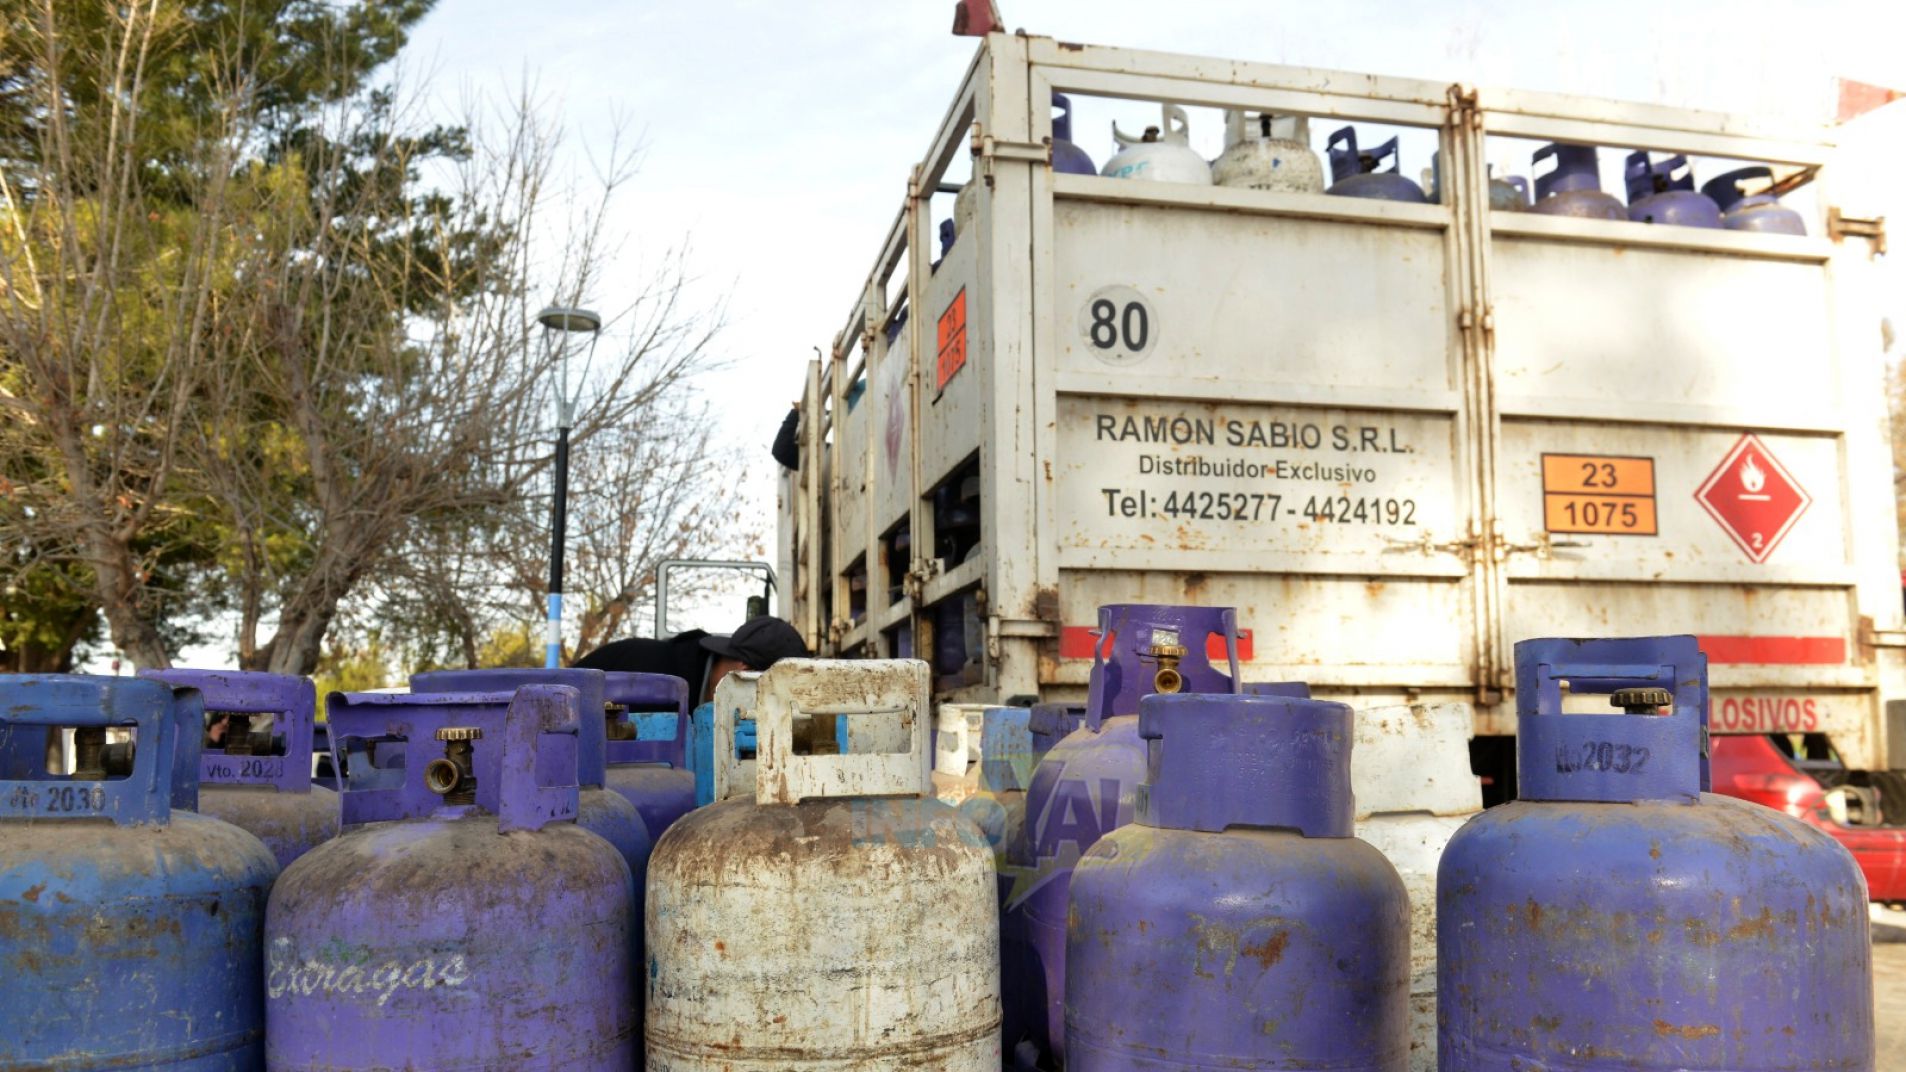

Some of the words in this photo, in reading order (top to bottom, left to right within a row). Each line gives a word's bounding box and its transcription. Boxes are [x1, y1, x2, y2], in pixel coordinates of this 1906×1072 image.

[1090, 299, 1149, 352] 80
[1226, 420, 1321, 449] SABIO
[1332, 425, 1415, 453] S.R.L.
[1139, 455, 1269, 478] Distribuidor
[1276, 460, 1376, 483] Exclusivo
[1581, 462, 1618, 488] 23
[1563, 502, 1638, 528] 1075
[1751, 532, 1764, 549] 2
[1710, 698, 1818, 731] LOSIVOS
[1582, 741, 1650, 773] 2032
